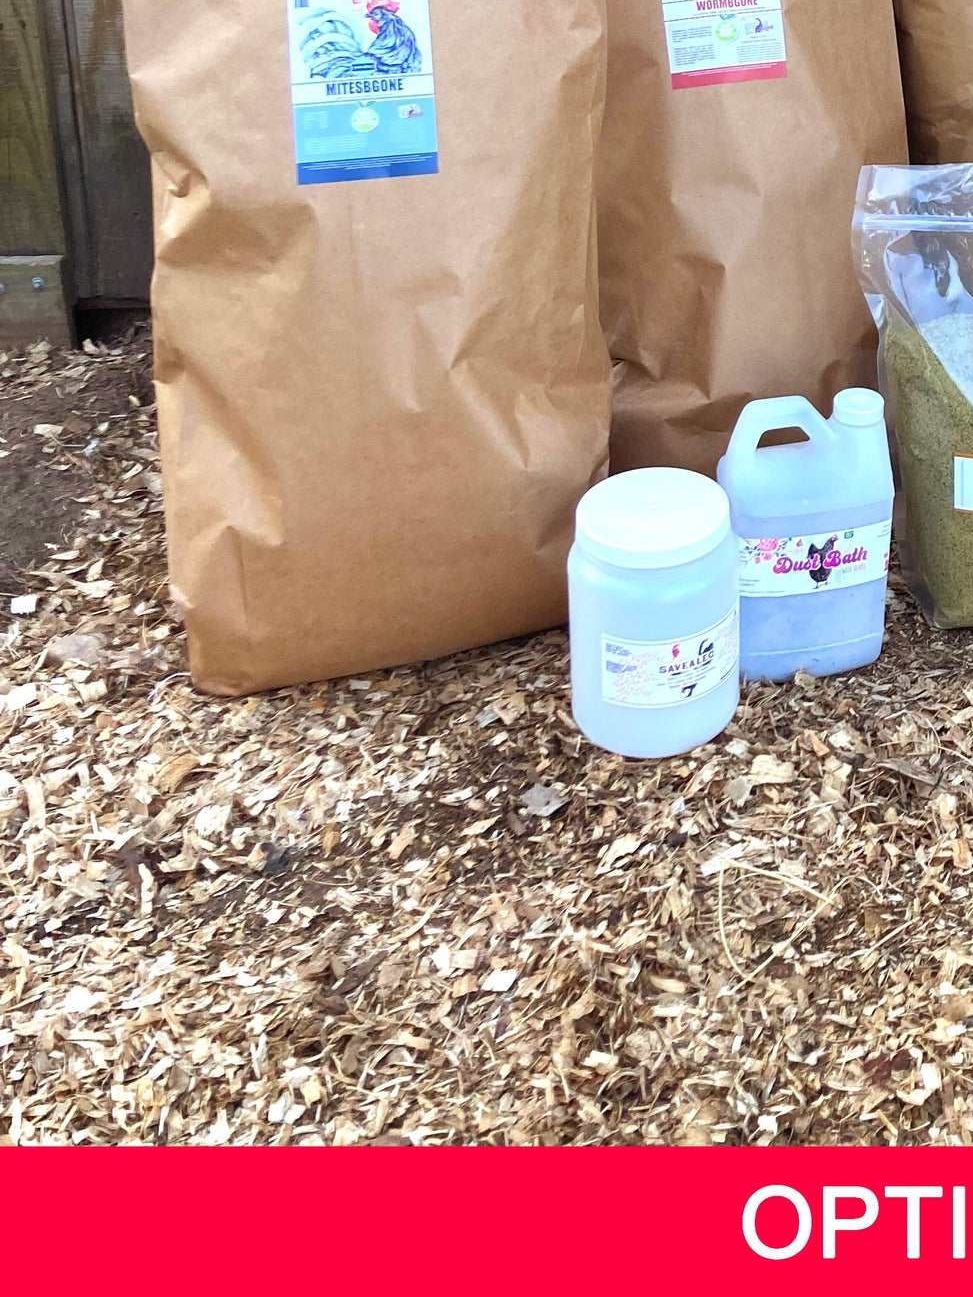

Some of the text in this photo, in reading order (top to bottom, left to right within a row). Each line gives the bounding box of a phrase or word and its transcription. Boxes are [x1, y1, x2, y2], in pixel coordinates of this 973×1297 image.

[325, 78, 405, 96] MITESBGONE
[772, 554, 821, 574] Dust
[822, 546, 868, 568] Bath
